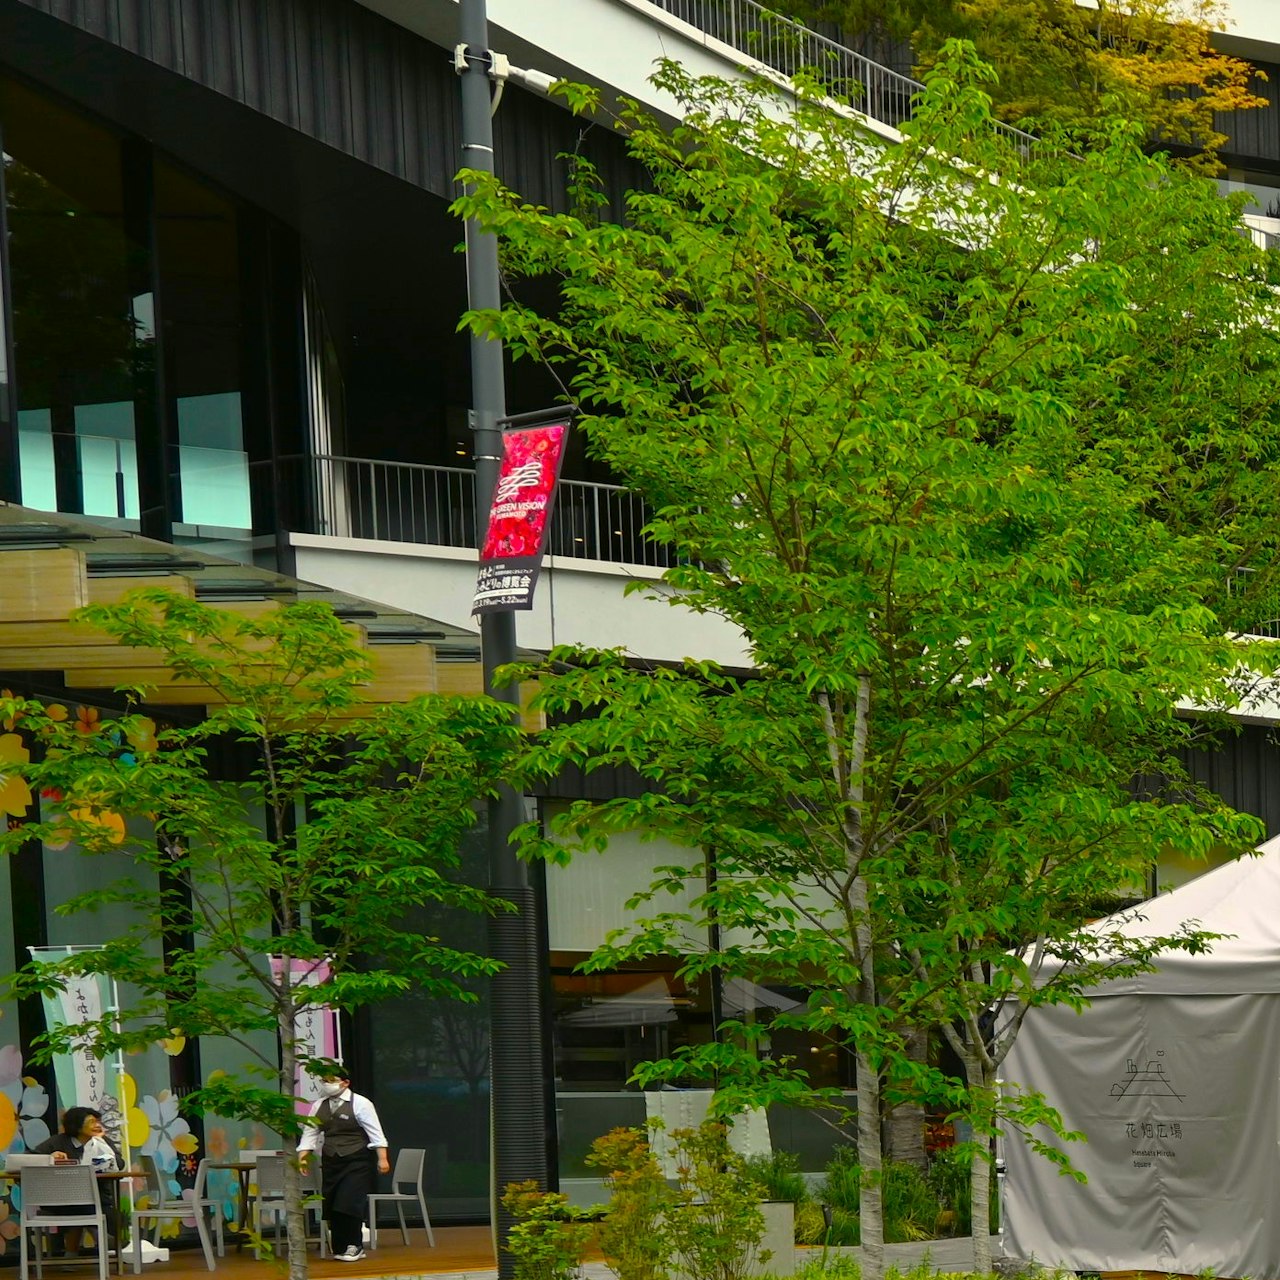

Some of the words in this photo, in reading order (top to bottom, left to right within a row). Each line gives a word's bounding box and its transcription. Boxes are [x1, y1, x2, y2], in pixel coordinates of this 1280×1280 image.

[518, 501, 545, 510] VISION
[1126, 1122, 1183, 1139] 花畑広場
